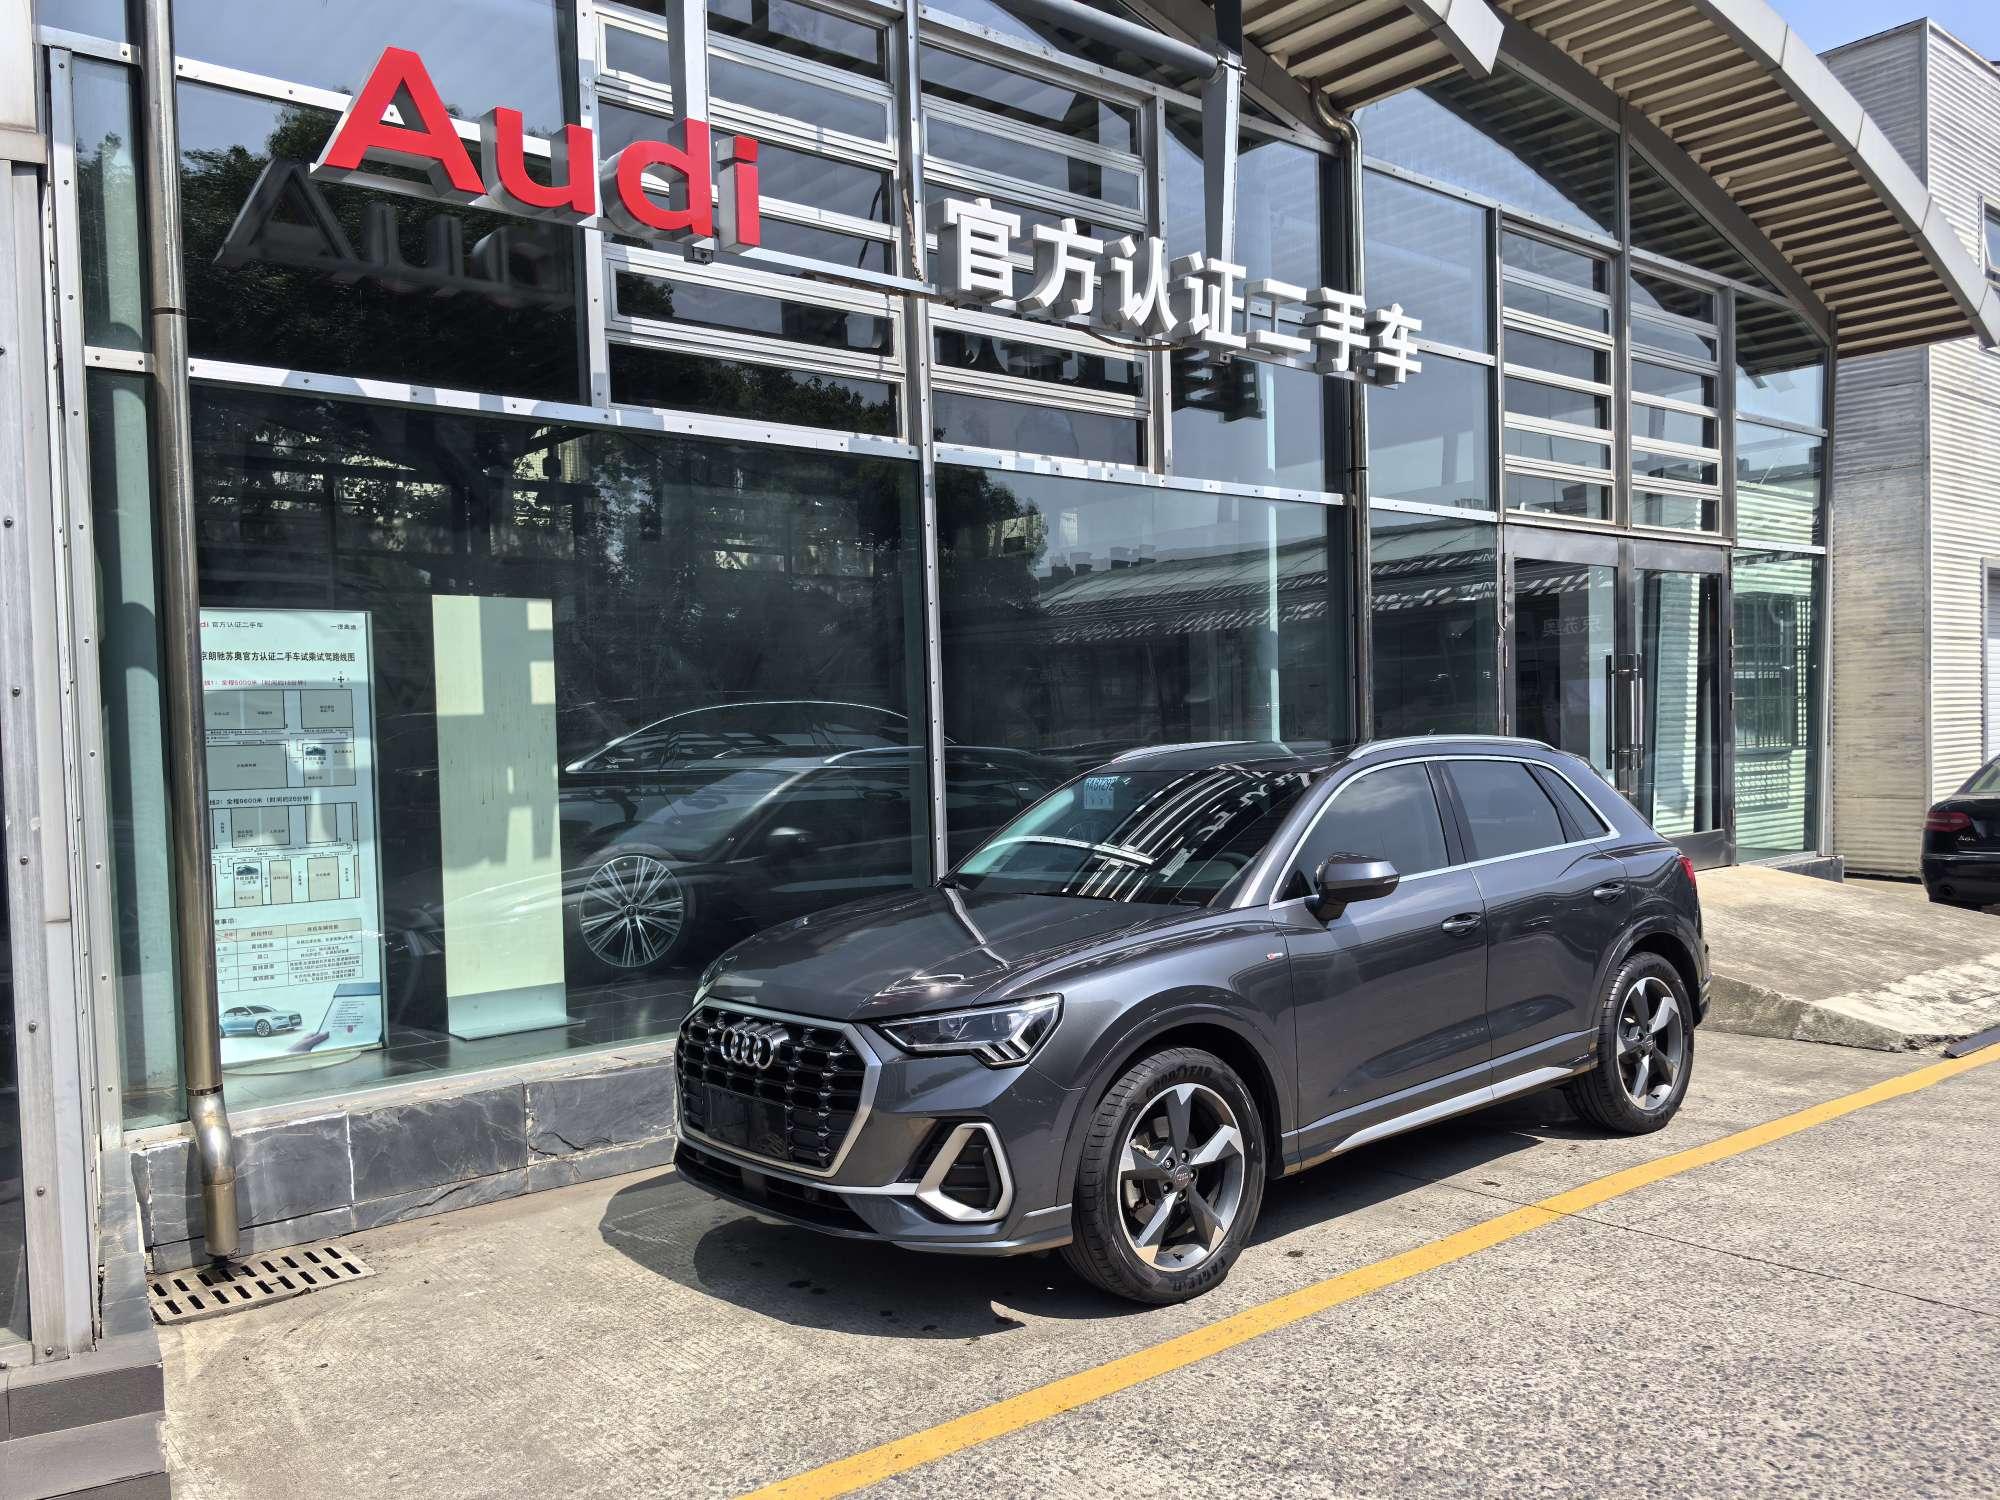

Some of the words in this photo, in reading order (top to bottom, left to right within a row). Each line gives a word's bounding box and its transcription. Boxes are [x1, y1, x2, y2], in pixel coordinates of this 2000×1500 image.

[313, 46, 761, 249] Audi
[941, 197, 1423, 386] 官方认证二手车
